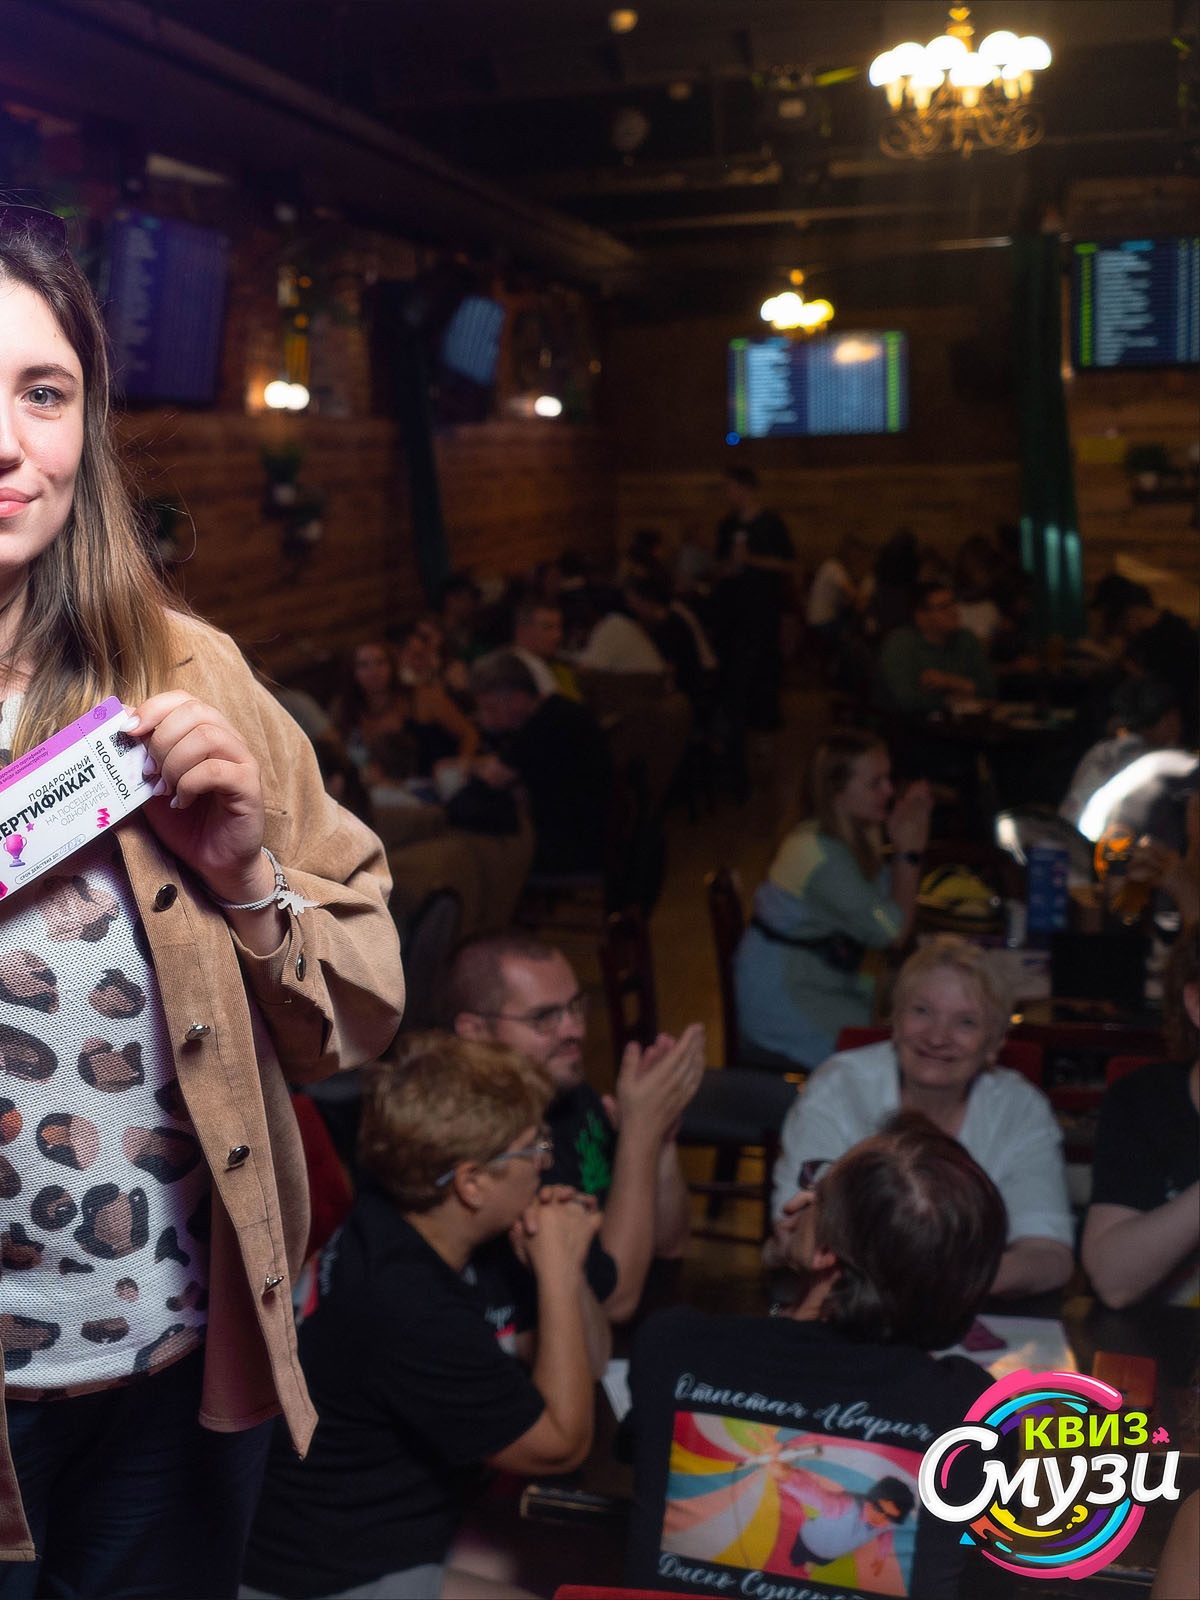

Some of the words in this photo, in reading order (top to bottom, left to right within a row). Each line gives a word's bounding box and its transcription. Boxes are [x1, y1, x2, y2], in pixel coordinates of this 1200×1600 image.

[28, 755, 91, 802] ПОДАРОЧНЫЙ
[95, 740, 131, 800] КОНТРОЛЬ
[45, 814, 58, 826] НА
[57, 781, 105, 817] ПОСЕЩЕНИЕ
[61, 803, 90, 826] ОДНОЙ
[89, 789, 110, 807] ИГРЫ
